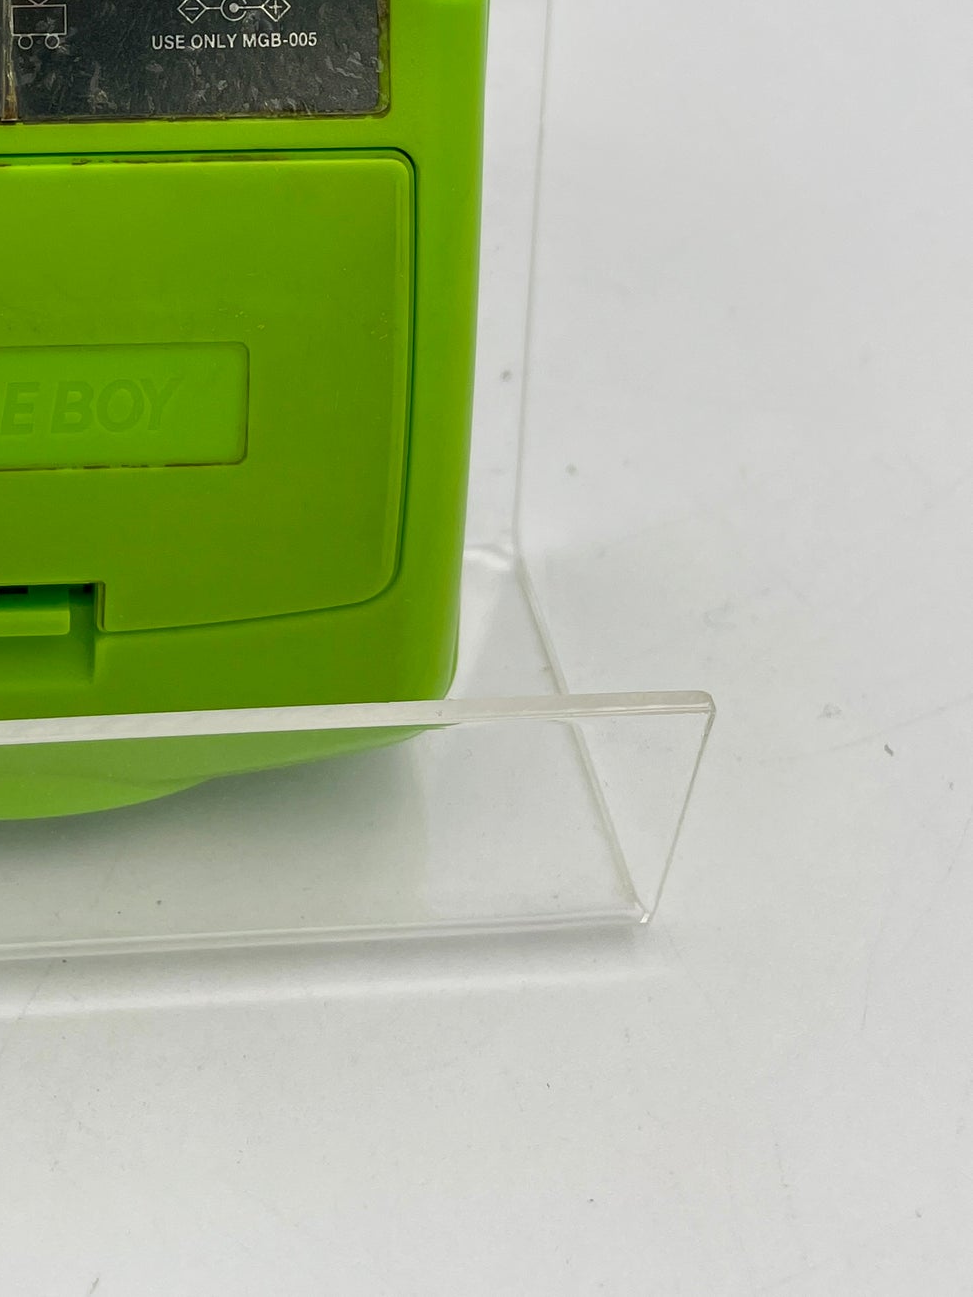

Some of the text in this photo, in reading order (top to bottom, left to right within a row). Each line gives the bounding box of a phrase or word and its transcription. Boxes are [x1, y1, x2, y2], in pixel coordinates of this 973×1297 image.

[152, 32, 317, 50] USE ONLY MGB-005
[51, 377, 181, 433] BOY
